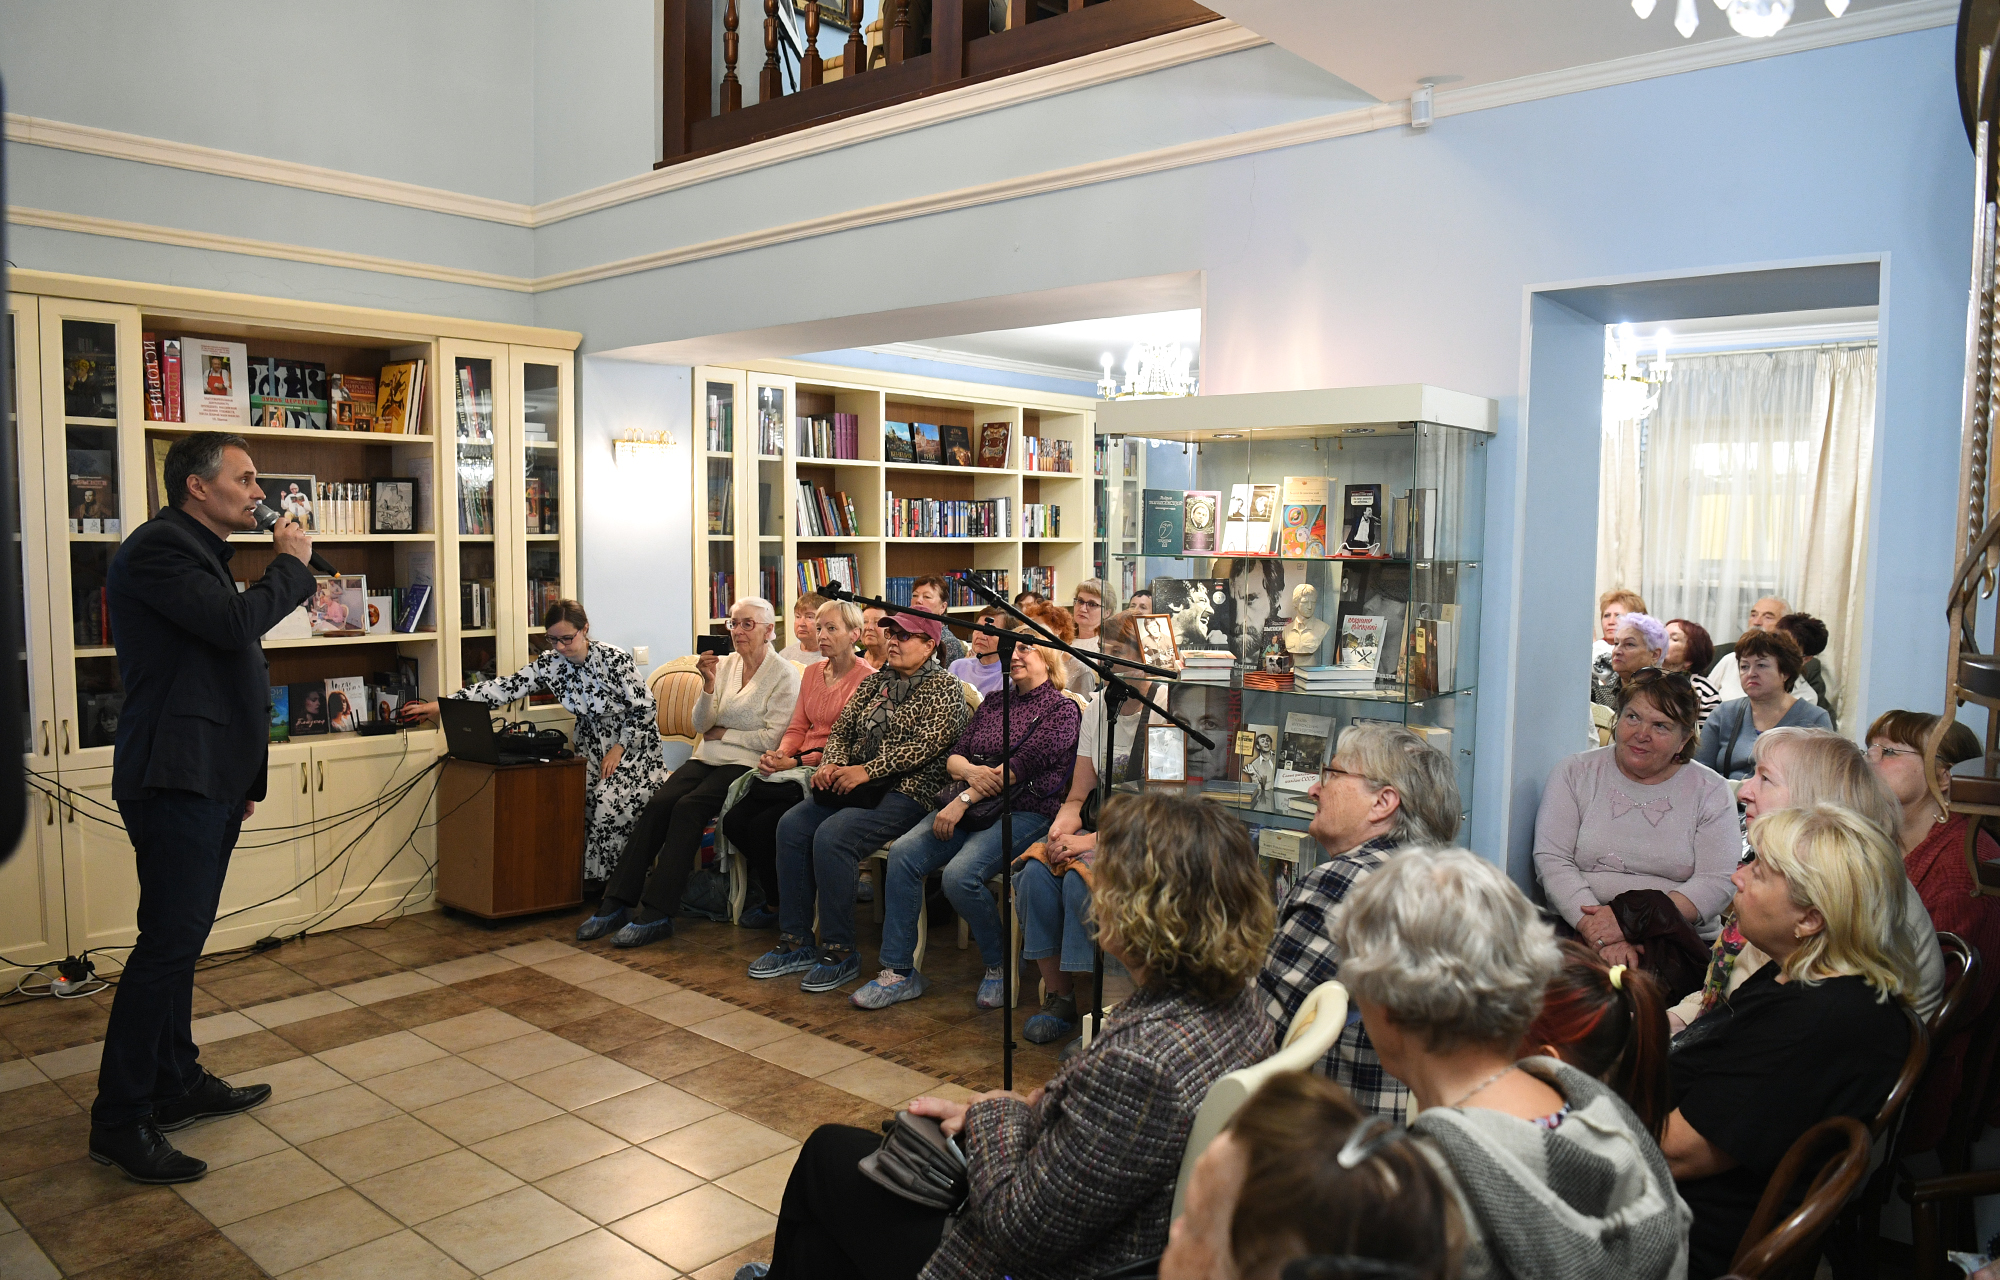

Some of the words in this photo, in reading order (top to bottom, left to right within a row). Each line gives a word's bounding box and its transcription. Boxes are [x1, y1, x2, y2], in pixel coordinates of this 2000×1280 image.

[143, 340, 163, 407] ИСТОРИЯ
[168, 372, 180, 420] РОССИЯ
[345, 383, 374, 391] МИРОВОЙ
